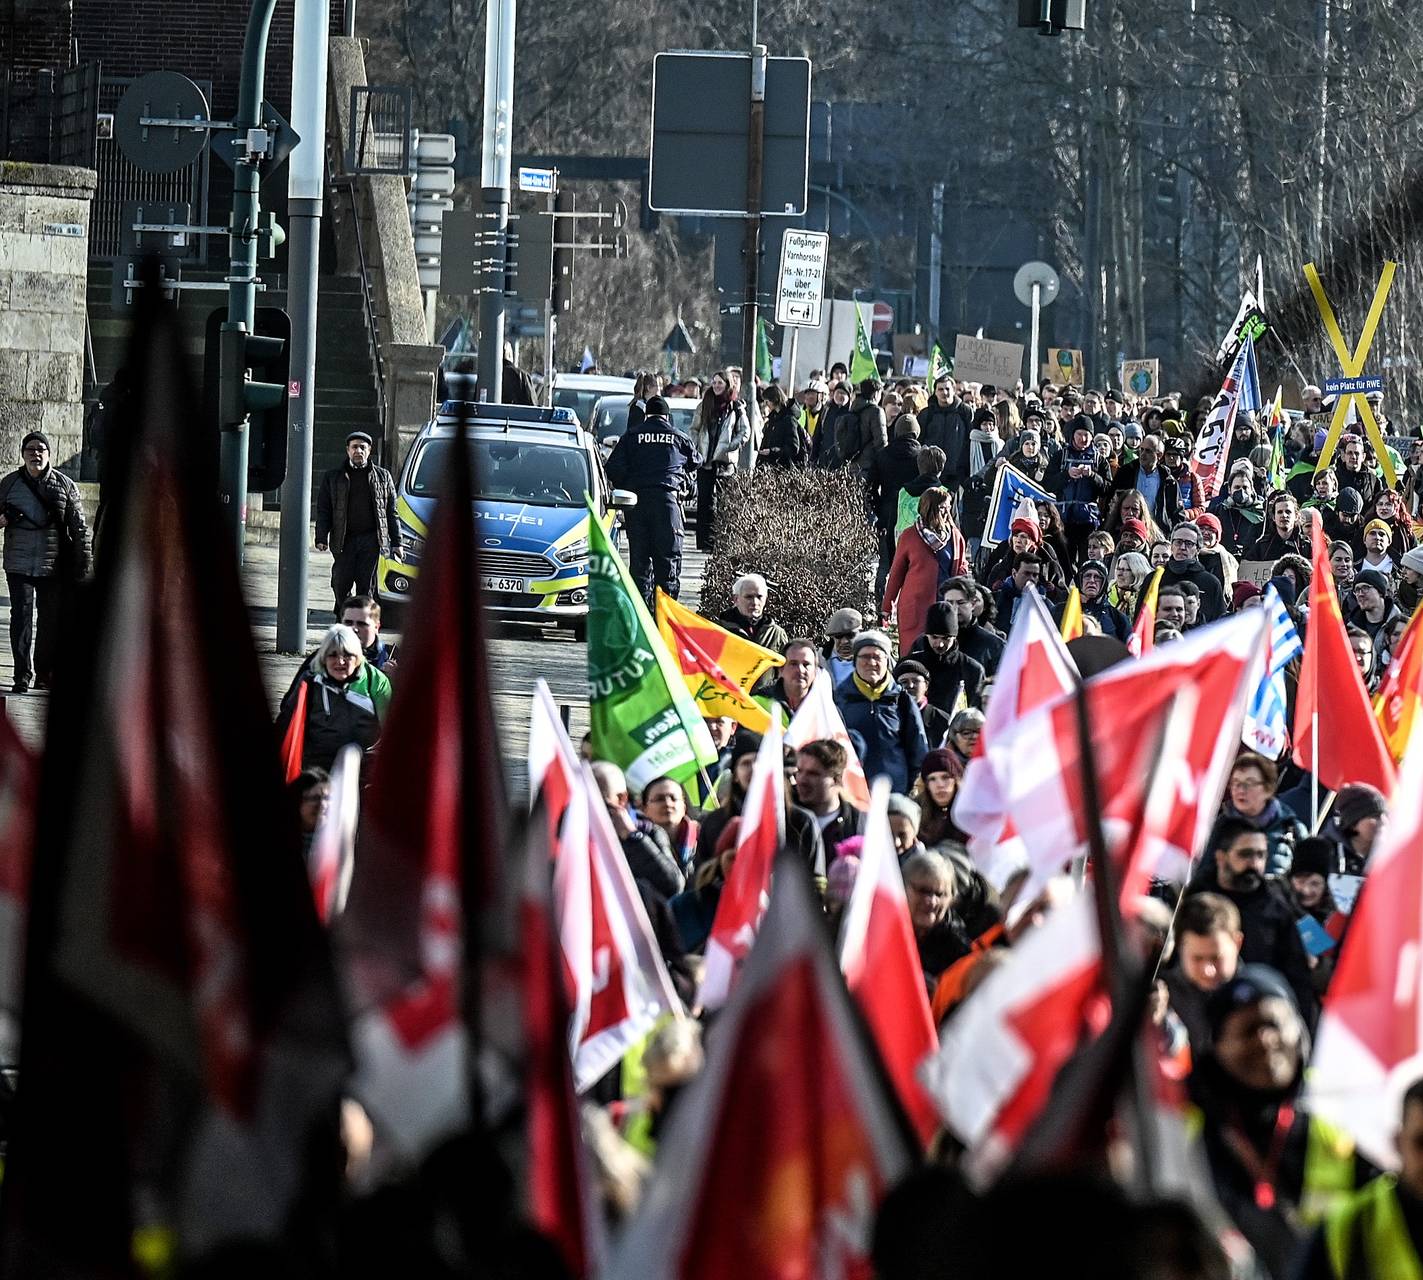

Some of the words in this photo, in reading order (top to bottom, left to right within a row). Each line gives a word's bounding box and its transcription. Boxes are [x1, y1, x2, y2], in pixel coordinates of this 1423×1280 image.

[789, 237, 821, 249] Fußgänger
[795, 279, 811, 288] über
[782, 288, 805, 298] Steeler
[1326, 383, 1339, 391] kein
[1340, 382, 1355, 390] Platz
[1356, 380, 1366, 389] für
[1367, 380, 1381, 388] RWE
[638, 433, 675, 444] POLIZEI
